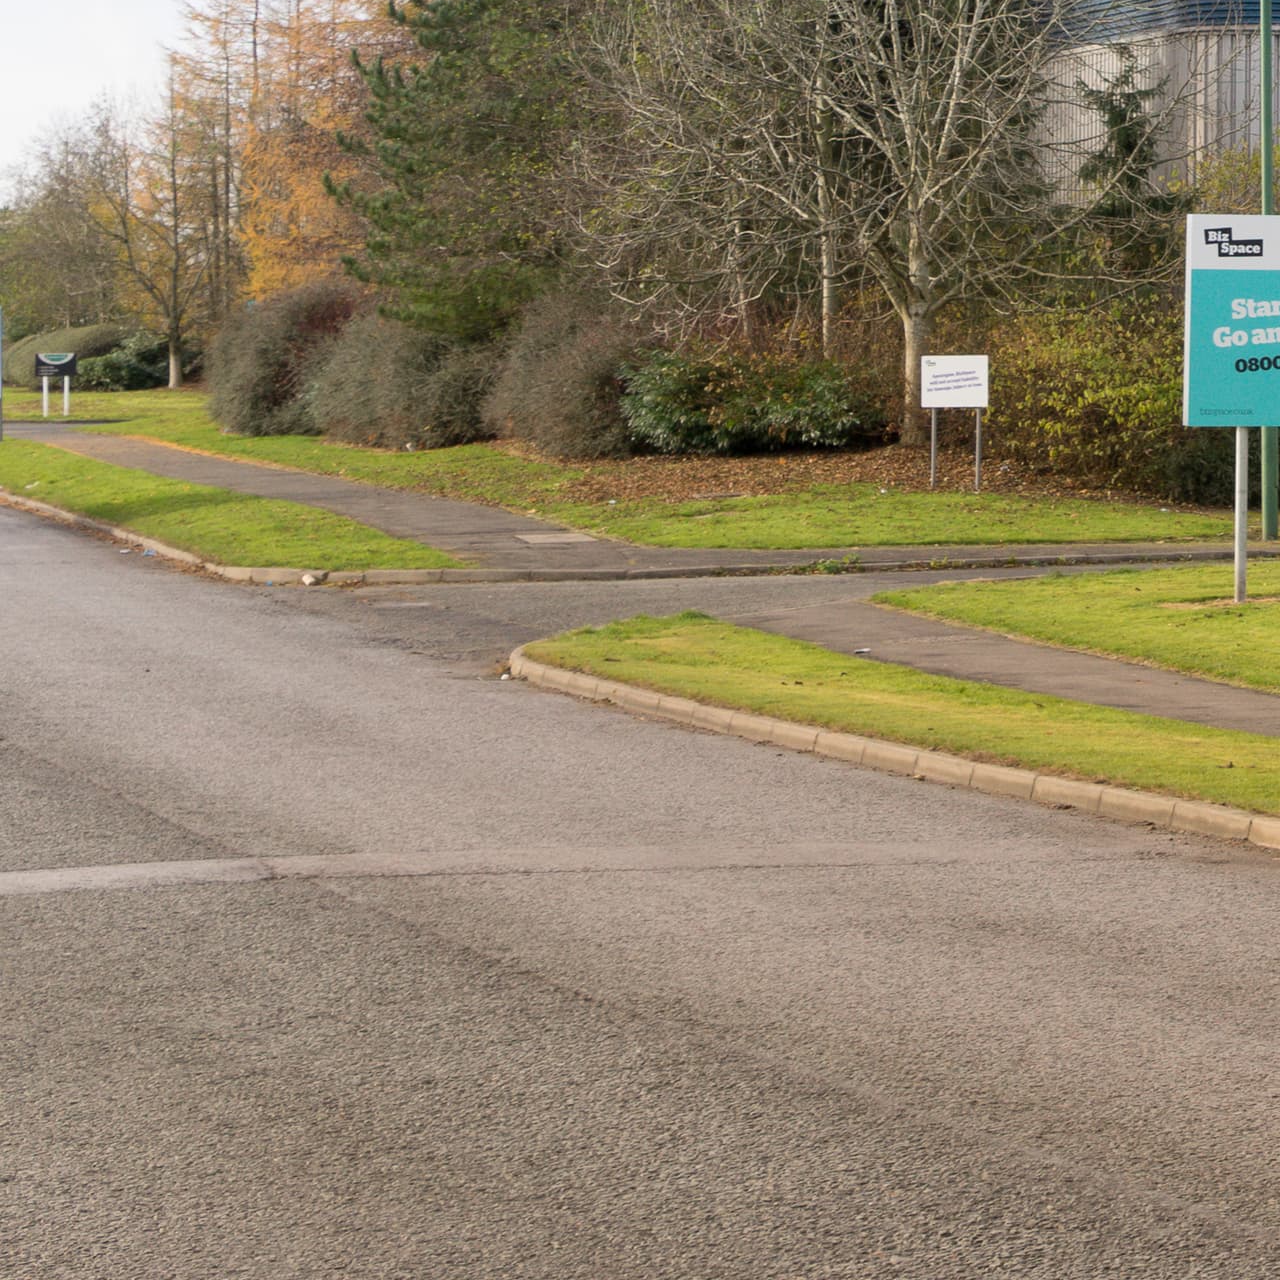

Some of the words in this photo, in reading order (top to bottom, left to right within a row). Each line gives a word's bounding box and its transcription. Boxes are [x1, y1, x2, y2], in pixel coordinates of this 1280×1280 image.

[1207, 231, 1229, 242] Biz
[1220, 242, 1261, 255] Space
[1212, 326, 1249, 347] Go
